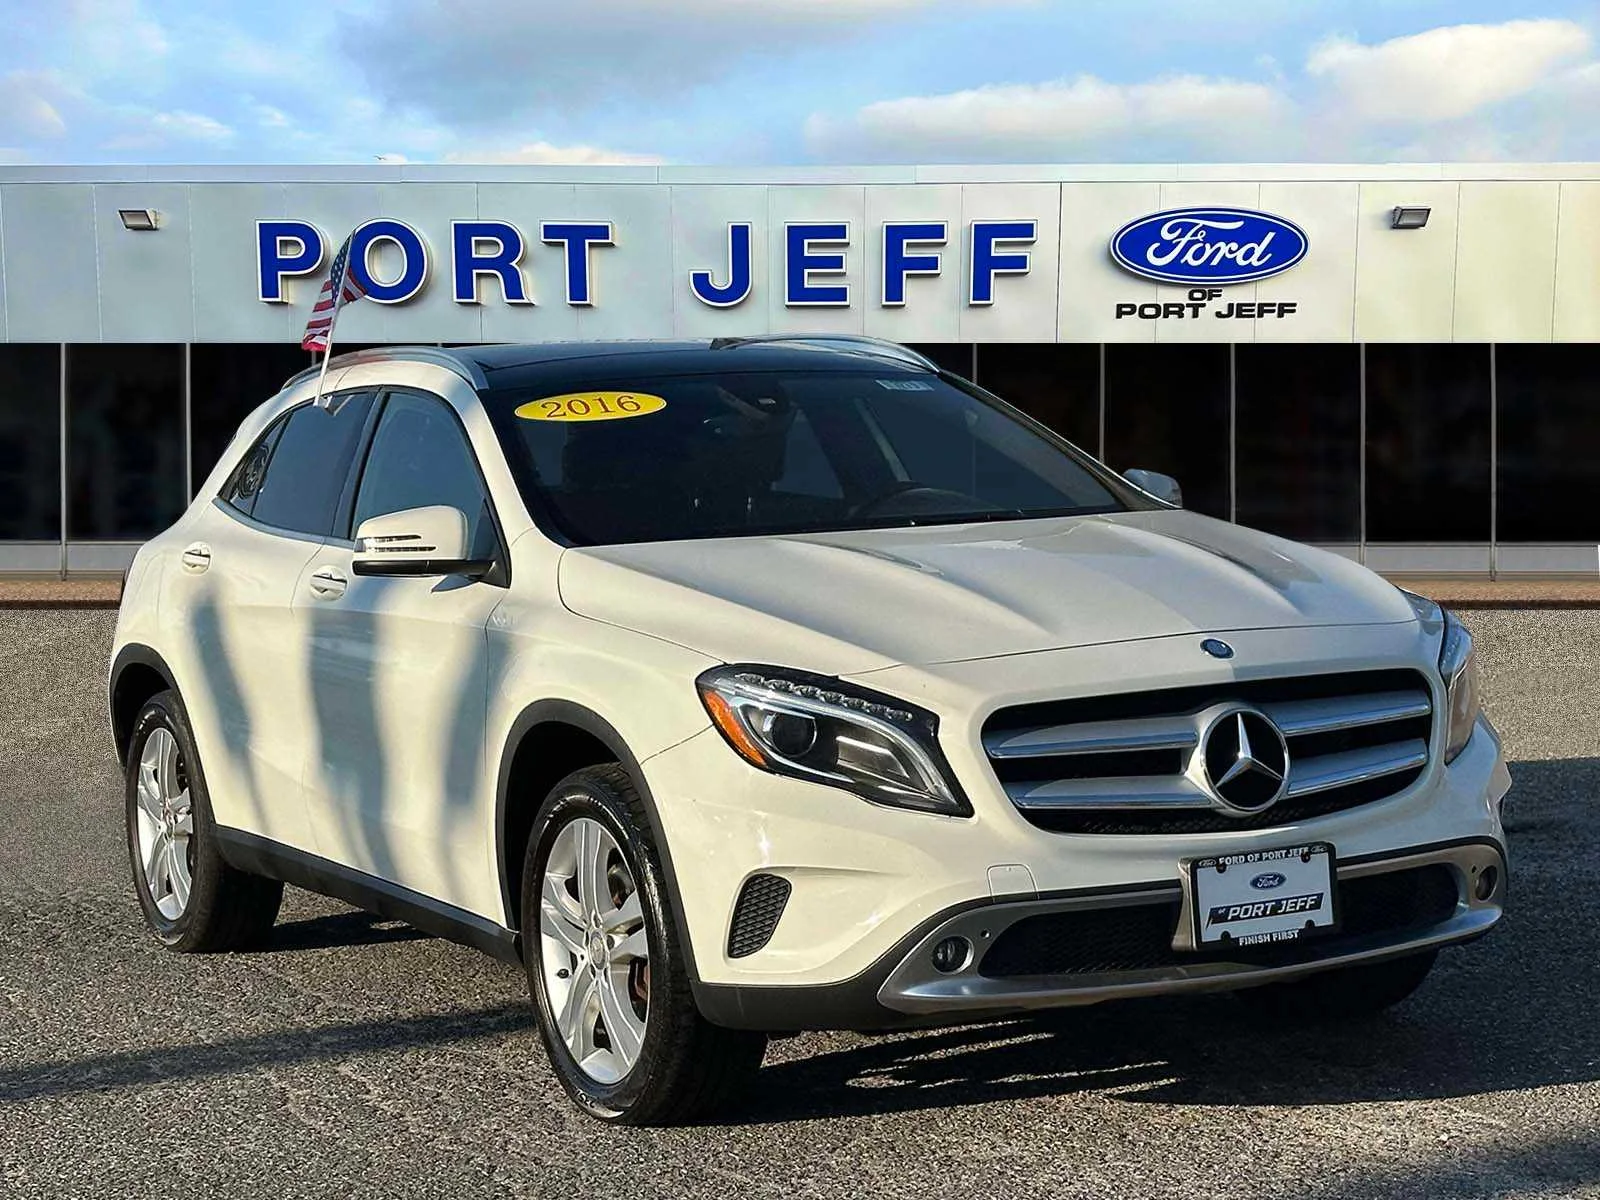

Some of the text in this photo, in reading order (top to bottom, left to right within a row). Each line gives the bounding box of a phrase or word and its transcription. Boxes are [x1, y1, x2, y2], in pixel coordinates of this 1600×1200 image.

[1147, 218, 1276, 266] Ford
[255, 218, 1039, 308] PORT JEFF
[1188, 289, 1223, 301] OF
[1115, 303, 1297, 319] PORT JEFF
[541, 395, 641, 418] 2016
[1218, 855, 1245, 866] FORD
[1247, 853, 1260, 862] OF
[1262, 849, 1287, 860] PORT
[1256, 876, 1281, 888] Ford
[1227, 902, 1276, 920] PORT
[1277, 896, 1318, 914] JEFF
[1239, 930, 1300, 946] FINISH FIRST
